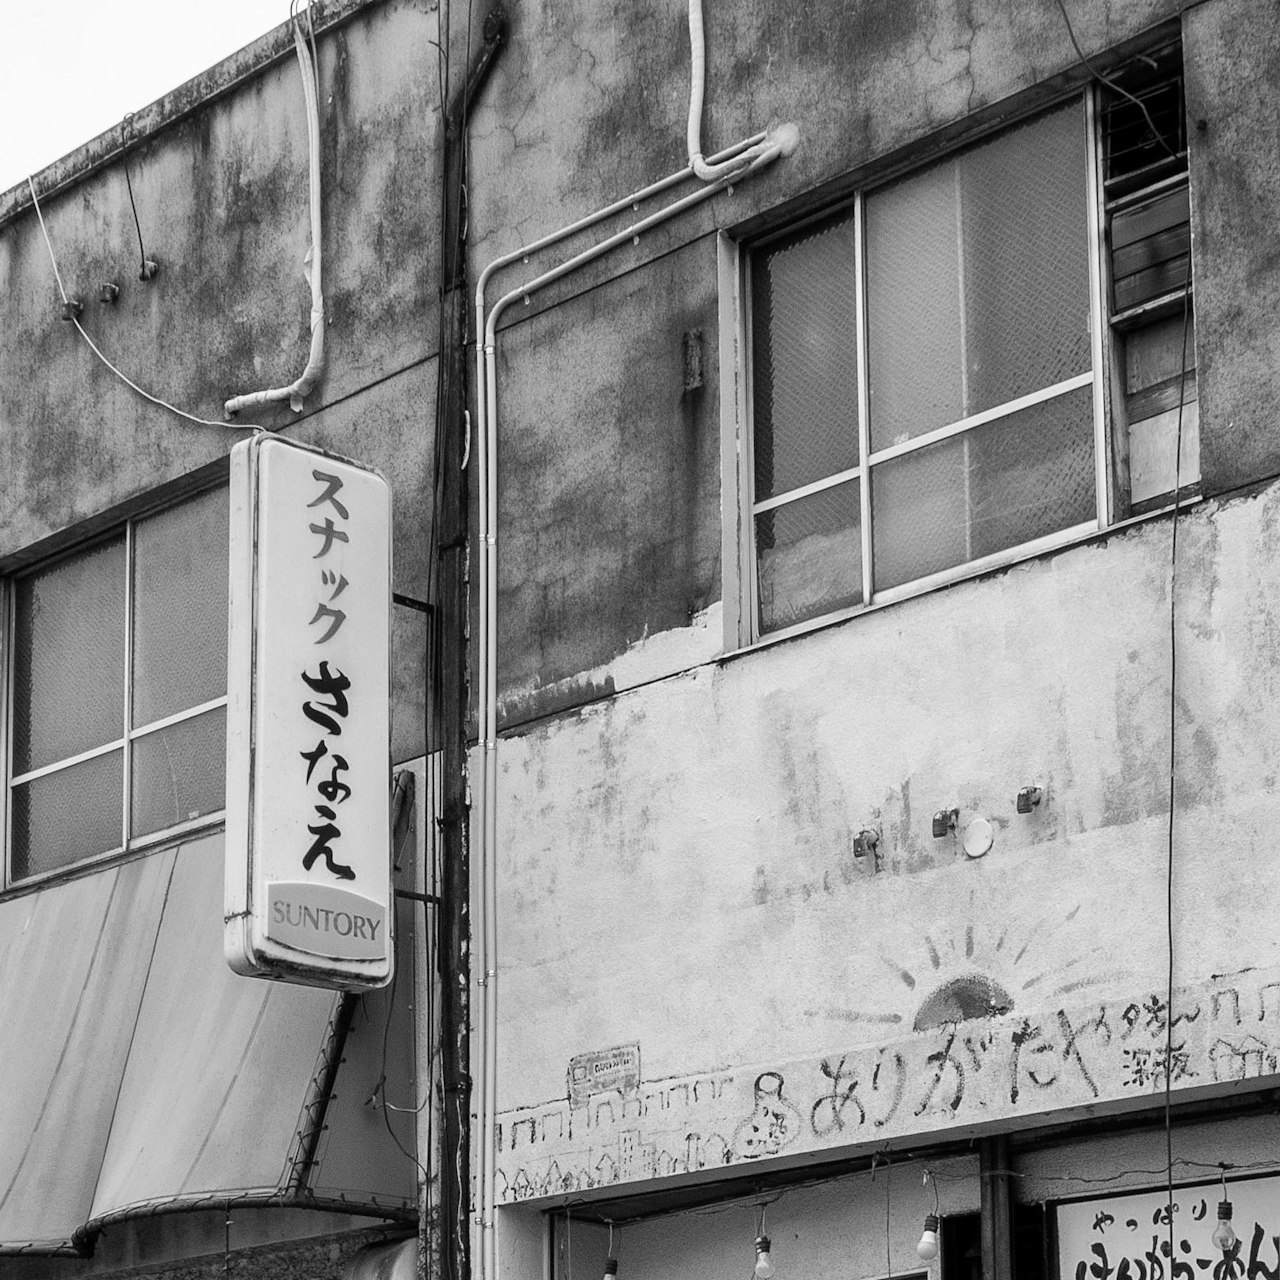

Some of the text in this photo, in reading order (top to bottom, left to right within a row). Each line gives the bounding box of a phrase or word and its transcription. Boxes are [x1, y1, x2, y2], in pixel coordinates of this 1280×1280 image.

[307, 469, 349, 645] スナック
[300, 660, 356, 881] さなえ
[272, 900, 384, 941] SUNTORY
[1093, 1198, 1207, 1234] やっぱり
